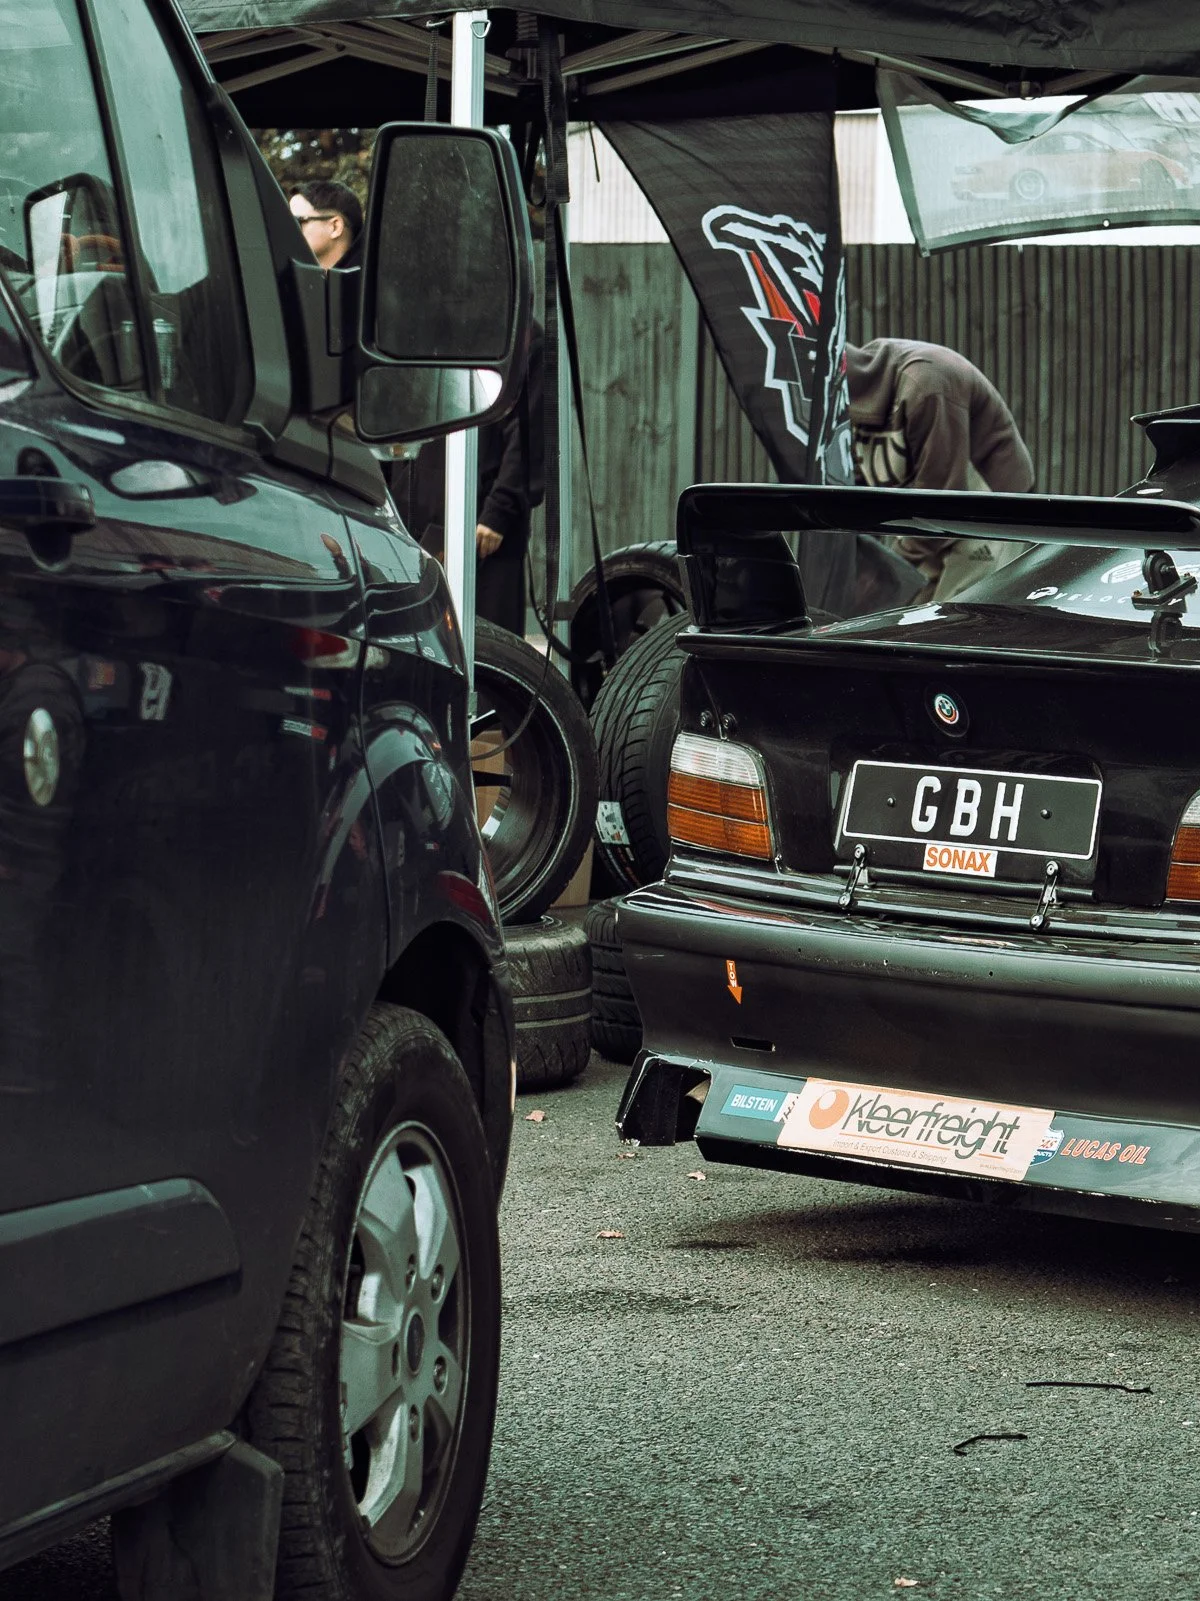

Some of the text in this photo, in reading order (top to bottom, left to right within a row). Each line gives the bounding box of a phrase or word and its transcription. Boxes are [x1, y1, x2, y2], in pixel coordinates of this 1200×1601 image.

[926, 846, 991, 873] SONAX
[729, 962, 738, 988] TOW
[731, 1093, 778, 1113] BILSTEIN
[832, 1140, 854, 1149] Import
[860, 1143, 881, 1154] Export
[883, 1146, 910, 1157] Customs
[917, 1151, 947, 1163] Shipping
[1060, 1138, 1121, 1161] LUCAS
[1119, 1145, 1151, 1165] OIL
